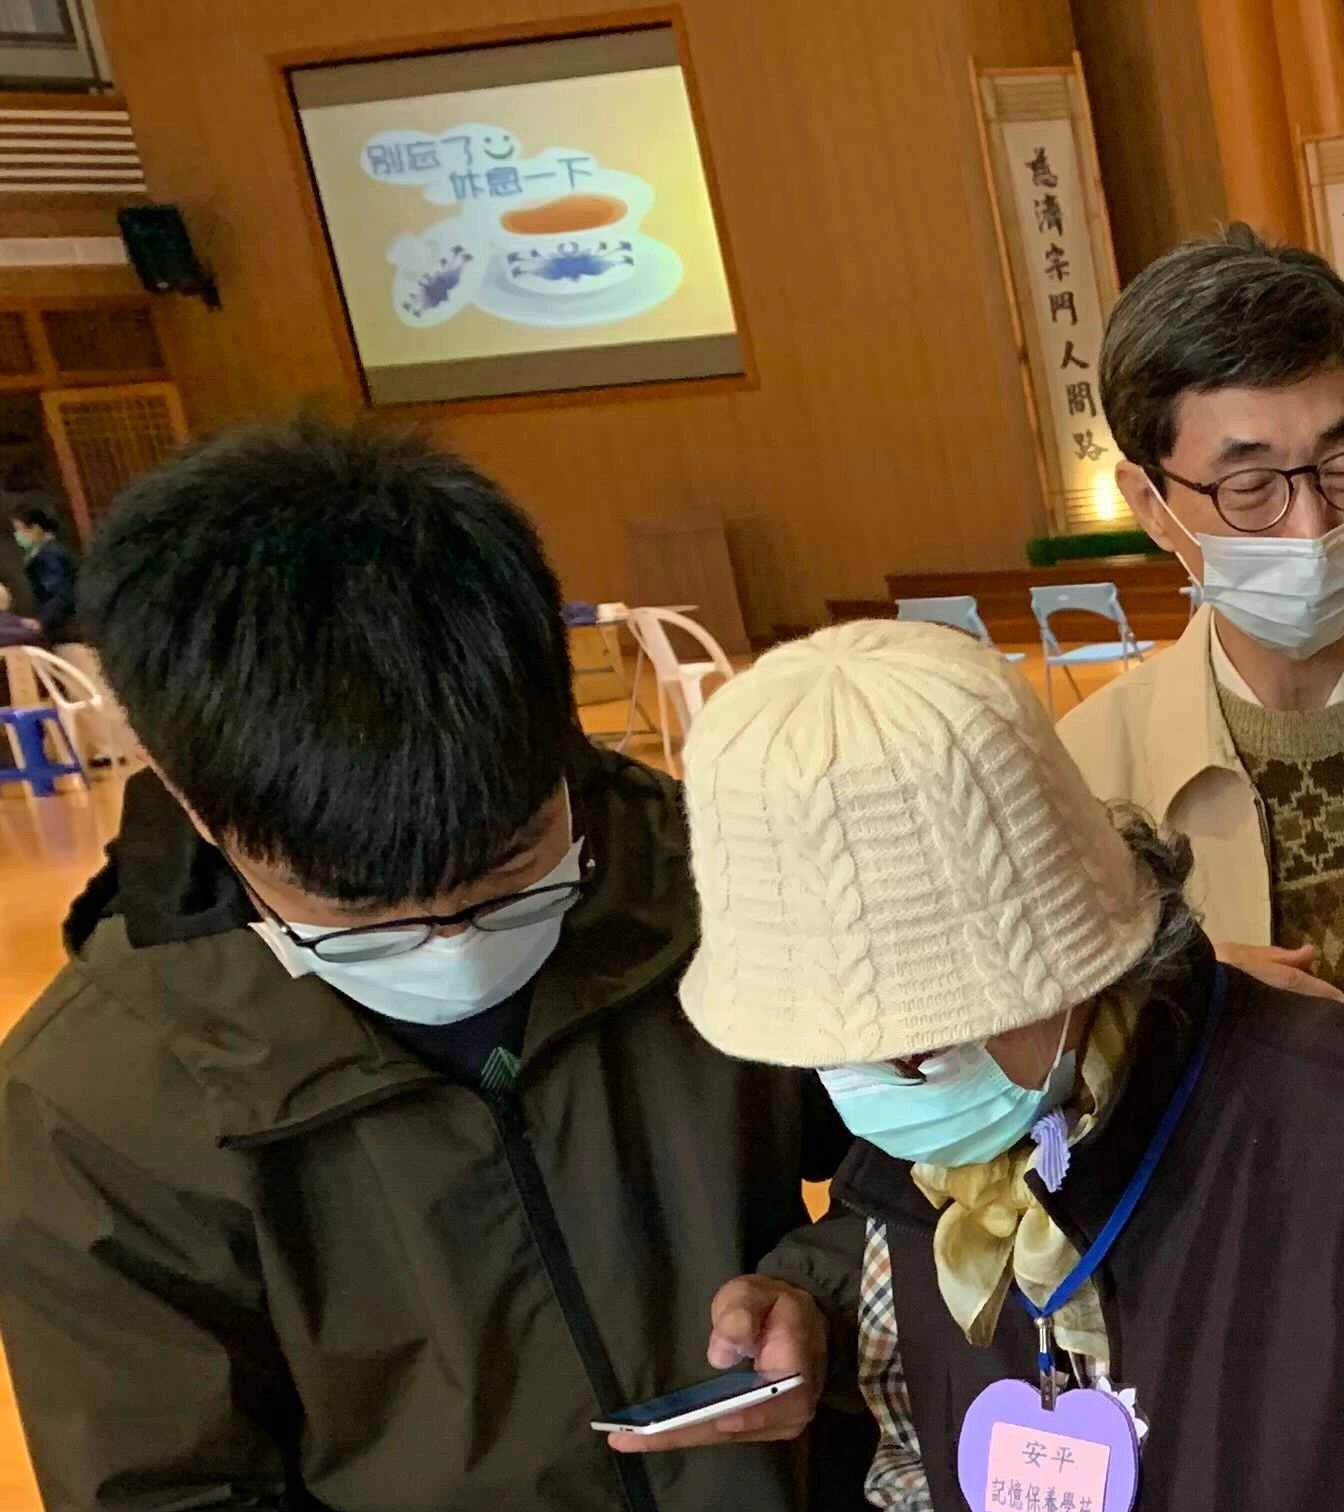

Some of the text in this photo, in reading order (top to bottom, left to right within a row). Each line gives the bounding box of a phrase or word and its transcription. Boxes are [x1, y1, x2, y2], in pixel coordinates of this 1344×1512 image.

[366, 136, 474, 177] 別忘了
[1025, 146, 1108, 463] 慈濟宗門人間路
[1021, 1440, 1076, 1473] 安平
